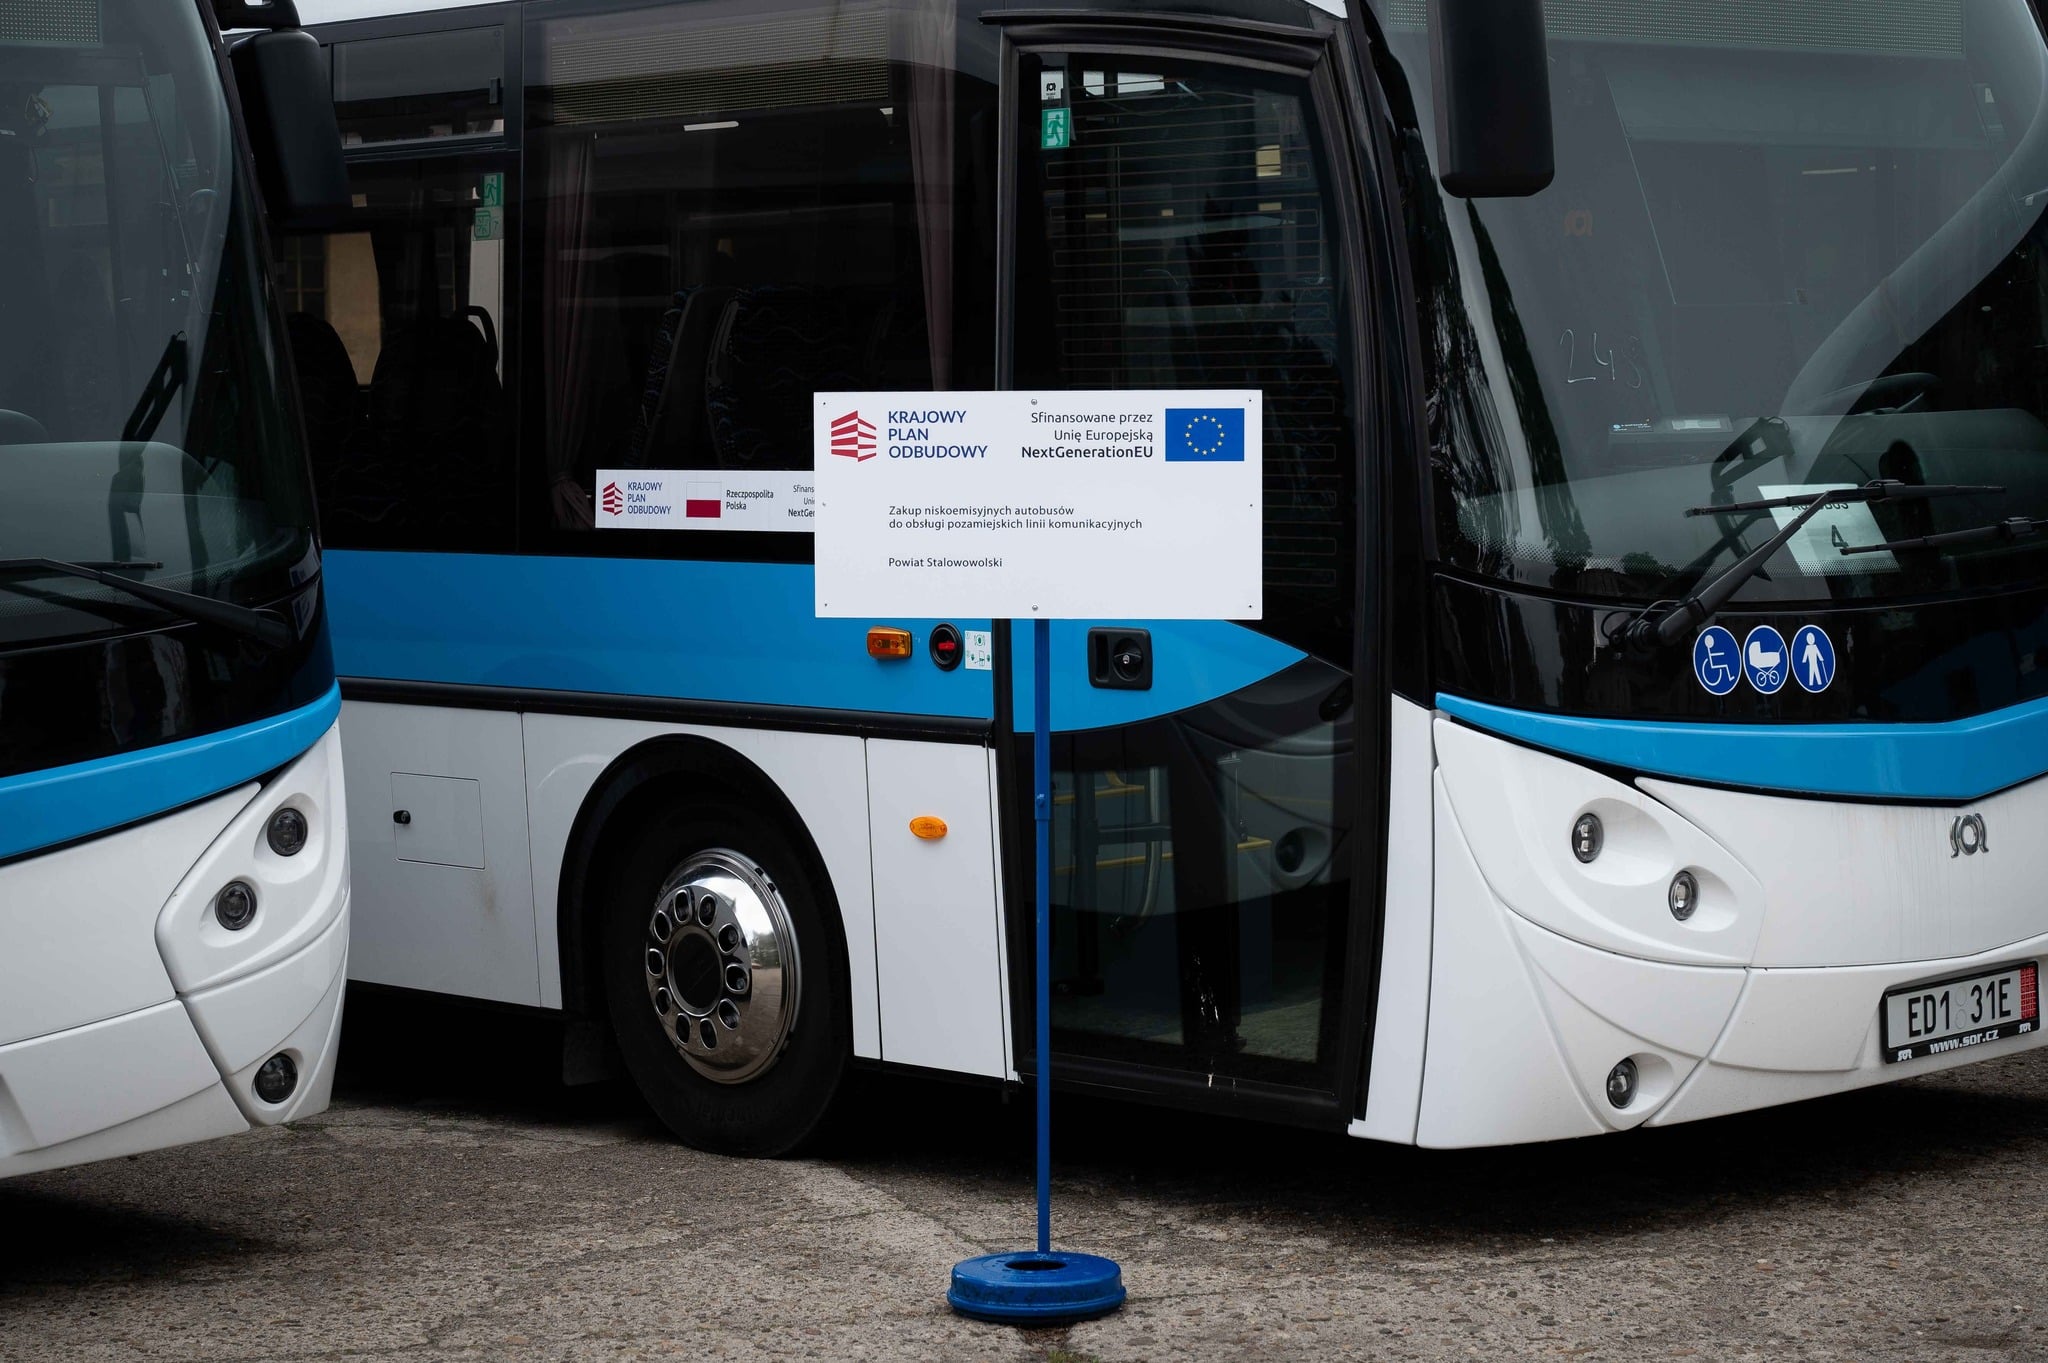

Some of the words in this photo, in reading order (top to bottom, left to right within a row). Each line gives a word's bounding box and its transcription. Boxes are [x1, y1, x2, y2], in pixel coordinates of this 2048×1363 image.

[888, 410, 967, 423] KRAJOWY
[1031, 411, 1116, 424] Sfinansowane
[1119, 413, 1153, 426] przez
[888, 428, 929, 441] PLAN
[1054, 429, 1082, 443] Unię
[1086, 429, 1153, 443] Europejską
[888, 445, 988, 459] ODBUDOWY
[1021, 446, 1153, 459] NextGenerationEU
[627, 481, 663, 491] KRAJOWY
[627, 493, 646, 503] PLAN
[726, 489, 774, 500] Rzeczpospolita
[627, 505, 671, 515] ODBUDOWY
[726, 501, 747, 511] Polska
[888, 506, 922, 517] Zakup
[924, 505, 1012, 518] niskoemisyjnych
[1014, 505, 1075, 516] autobusów
[888, 518, 903, 529] do
[905, 518, 945, 531] obsługi
[947, 518, 1023, 531] pozamiejskich
[1025, 518, 1046, 529] linii
[1048, 518, 1143, 531] komunikacyjnych
[1831, 524, 1849, 548] 4
[888, 557, 924, 568] Powiat
[927, 557, 1003, 568] Stalowowolski
[1907, 990, 1950, 1038] ED1
[1970, 977, 2011, 1024] 31E
[1929, 1029, 1999, 1054] www.sor.cz
